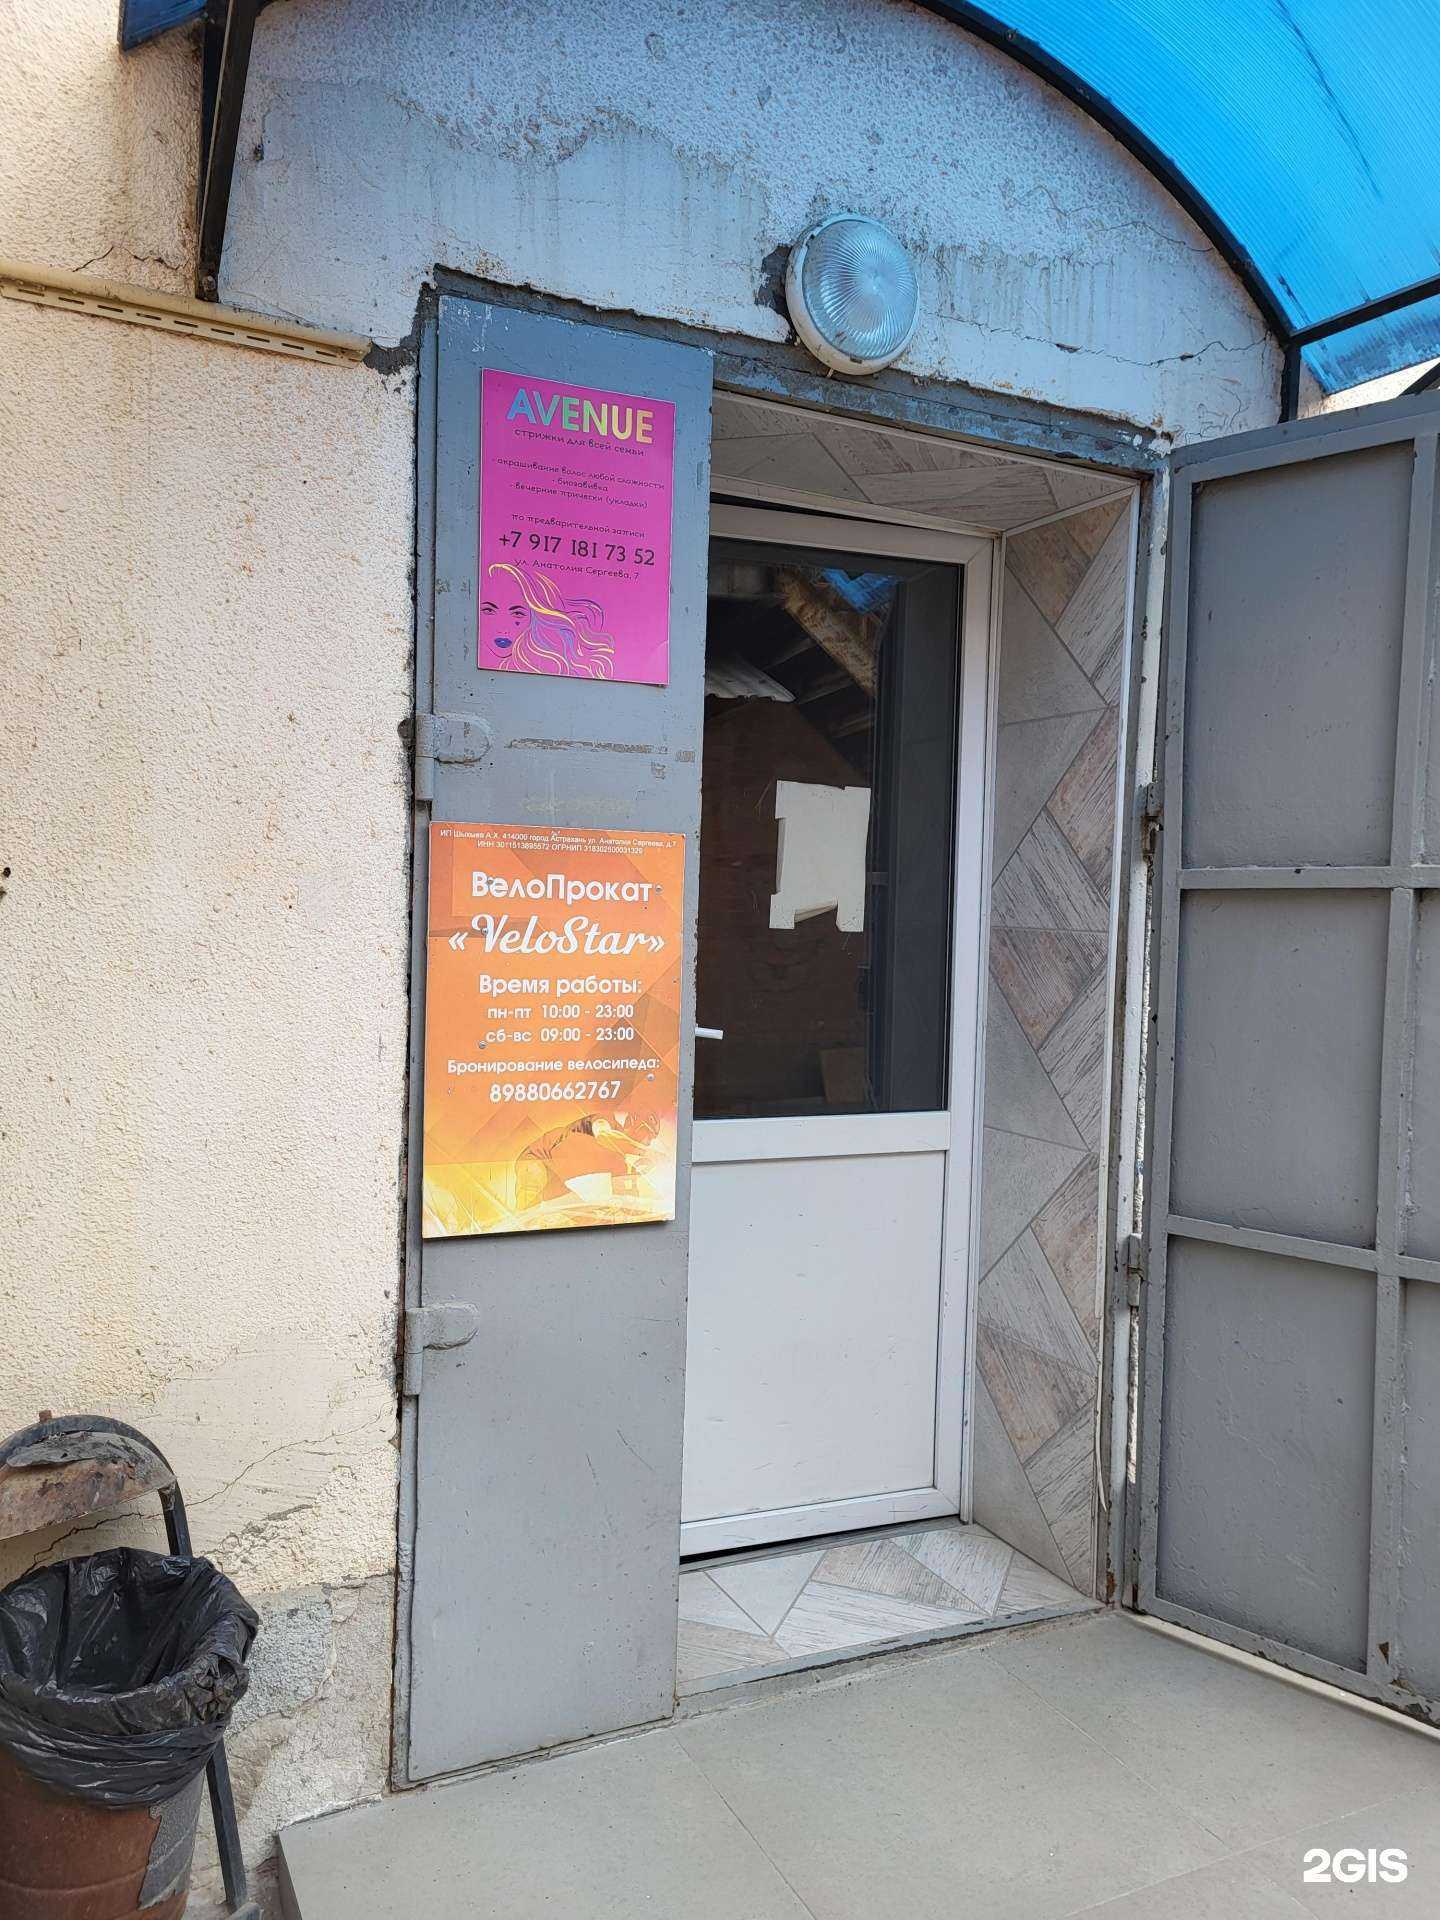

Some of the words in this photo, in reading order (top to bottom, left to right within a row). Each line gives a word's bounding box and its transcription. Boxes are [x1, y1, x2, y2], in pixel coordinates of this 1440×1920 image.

[506, 388, 654, 445] AVENUE
[514, 428, 565, 444] стрижки
[566, 438, 588, 448] для
[588, 440, 611, 451] всей
[614, 445, 645, 457] семьи
[497, 458, 560, 474] окрашивание
[561, 465, 586, 477] волос
[588, 470, 616, 482] любой
[616, 477, 665, 490] сложности
[557, 477, 608, 492] биозавивка
[515, 482, 557, 496] вечерние
[560, 489, 603, 503] прически
[605, 495, 648, 510] (укладки)
[527, 516, 611, 534] предварительной
[612, 528, 645, 539] записи
[499, 530, 523, 548] +7
[529, 533, 562, 554] 917
[571, 539, 598, 559] 181
[605, 544, 626, 563] 73
[634, 548, 655, 566] 52
[514, 558, 529, 568] ул.
[533, 559, 584, 574] Анатолия
[585, 566, 632, 581] Сергеева,
[634, 572, 640, 580] 7
[440, 829, 452, 838] ИП
[502, 832, 528, 841] 414000
[529, 834, 549, 844] город
[551, 842, 582, 852] ОГРНИП
[472, 871, 652, 905] ВелоПрокат
[448, 914, 665, 955] «VeloStar»
[479, 974, 550, 997] Время
[556, 974, 643, 998] работы:
[487, 1005, 532, 1020] пн-пт
[542, 1004, 581, 1019] 10:00
[595, 1004, 634, 1018] 23:00
[485, 1028, 532, 1043] сб-вс
[540, 1027, 581, 1042] 09:00
[596, 1027, 634, 1041] 23:00
[447, 1058, 564, 1075] Бронирование
[567, 1056, 660, 1071] велосипеда:
[489, 1080, 621, 1103] 89880662767
